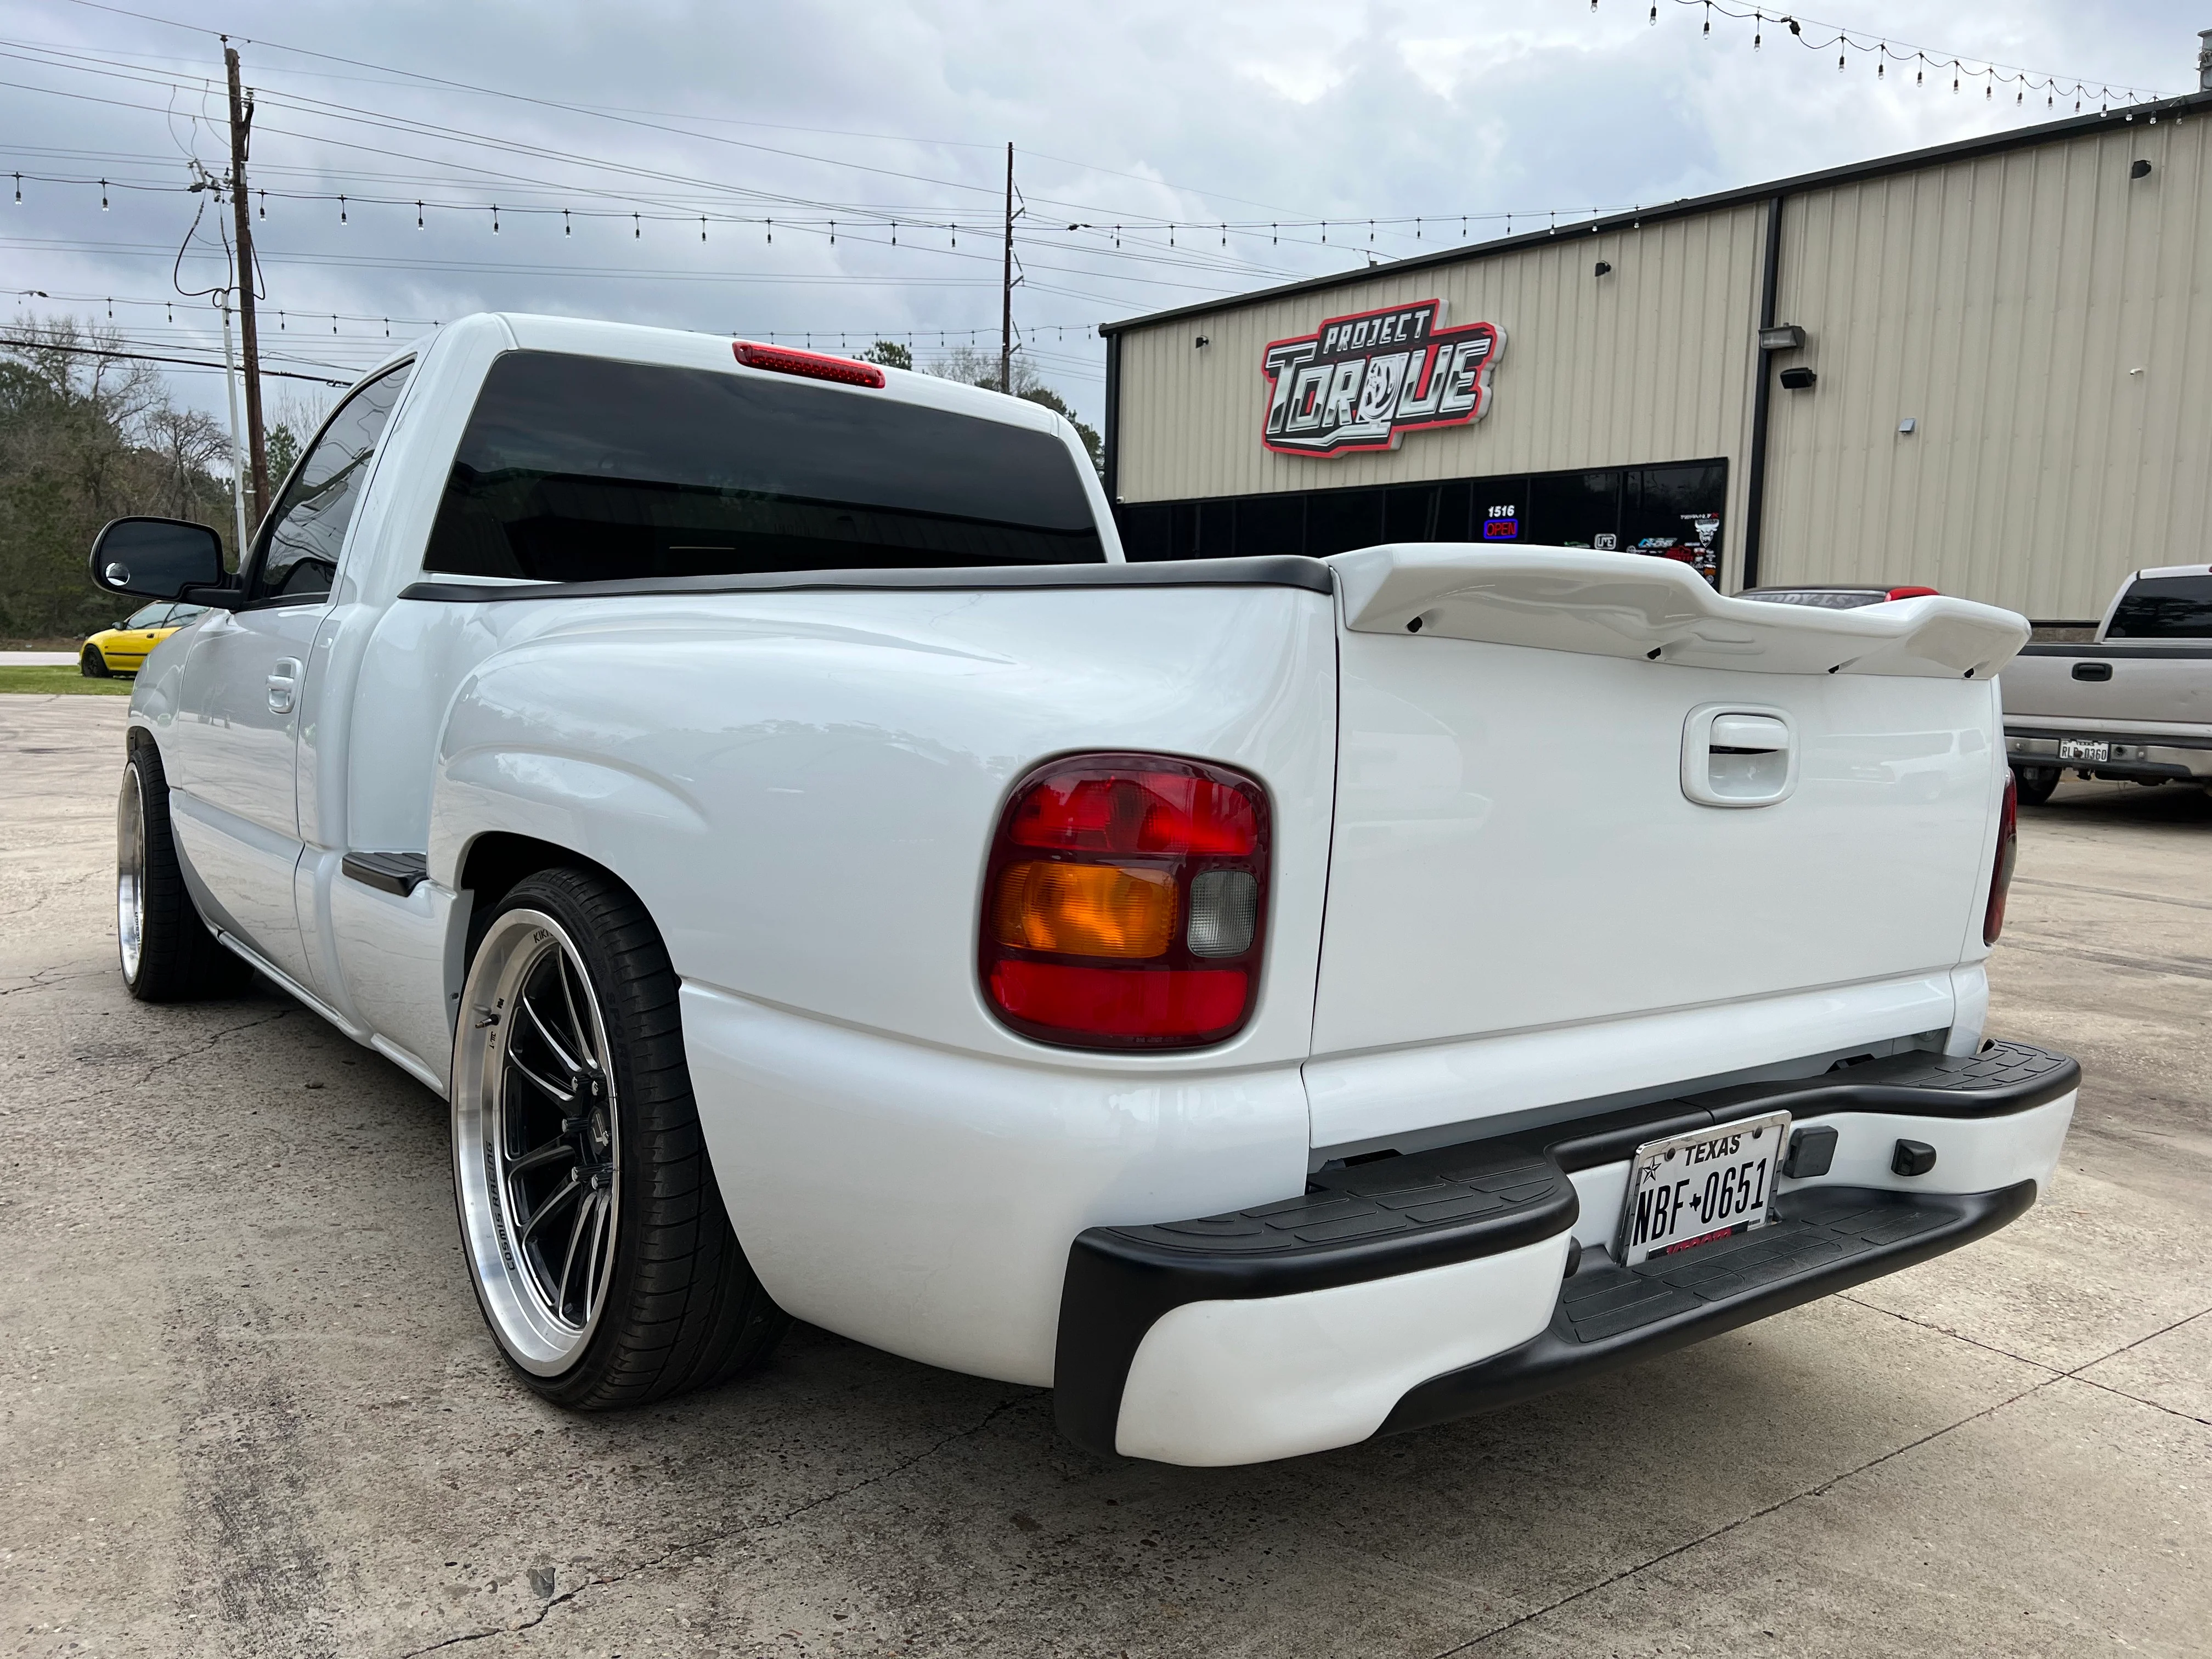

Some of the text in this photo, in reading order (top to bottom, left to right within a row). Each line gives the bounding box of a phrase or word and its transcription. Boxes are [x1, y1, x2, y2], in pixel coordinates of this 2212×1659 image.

[1322, 309, 1431, 354] PROJECT
[1265, 338, 1491, 437] TORQUE
[1487, 522, 1516, 536] OPEN
[1488, 505, 1515, 517] 1516
[1685, 1134, 1741, 1166] TEXAS
[486, 1141, 515, 1271] COSMIS RACING
[1633, 1178, 1690, 1246] NBF
[1701, 1158, 1767, 1224] 0651
